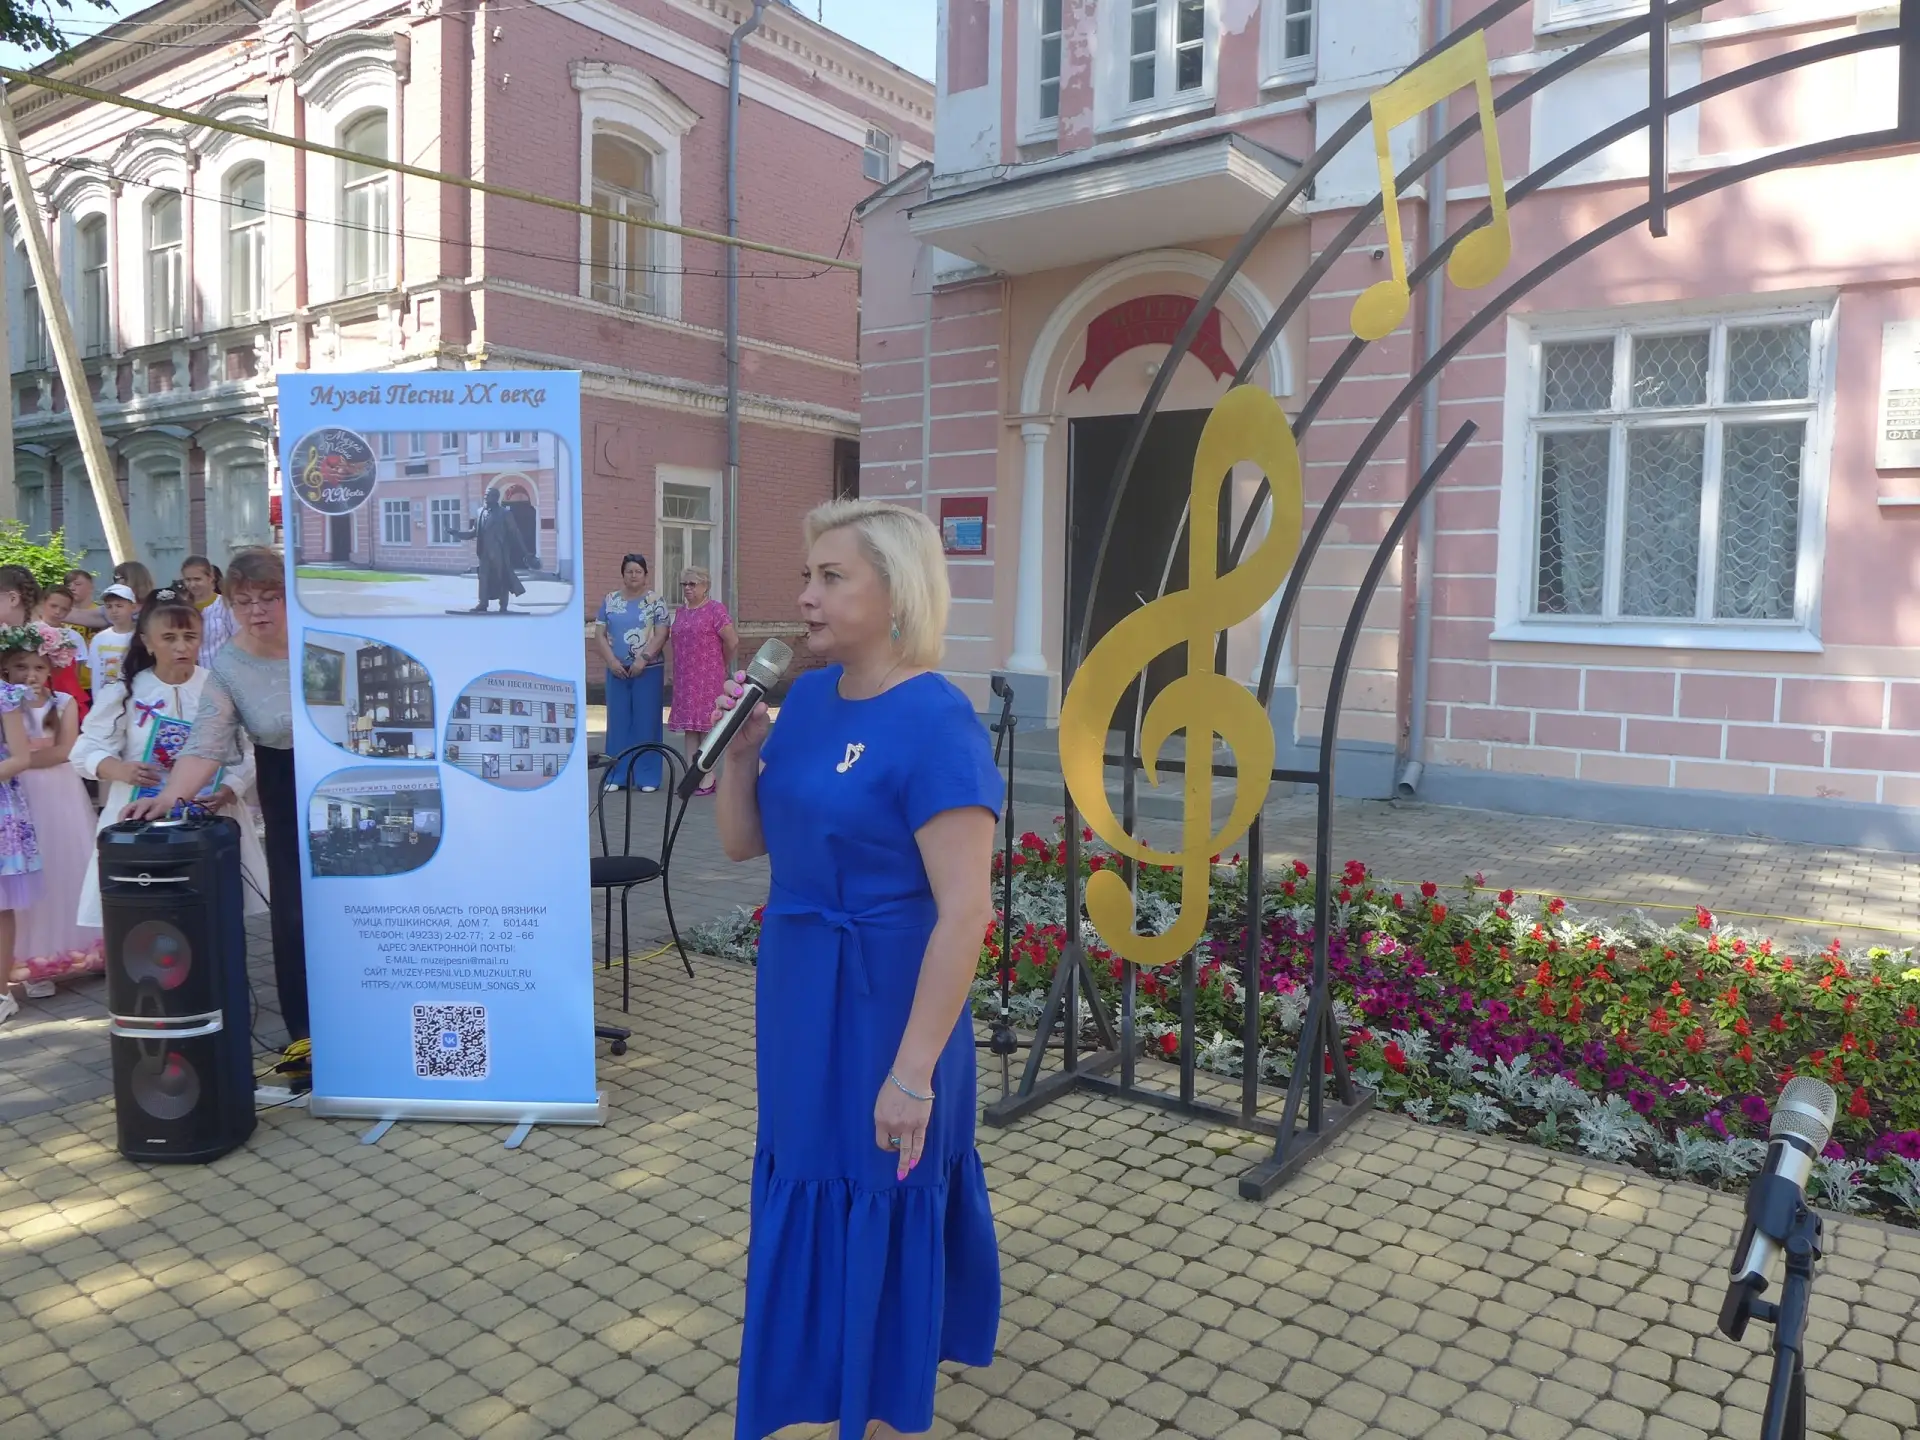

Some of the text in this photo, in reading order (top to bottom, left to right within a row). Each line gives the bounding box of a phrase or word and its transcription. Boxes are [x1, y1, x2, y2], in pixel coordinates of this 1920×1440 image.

[309, 382, 546, 411] Музей Песни XX века
[344, 906, 546, 915] ВЛАДИМИРСКАЯ ОБЛАСТЬ ГОРОД ВЯЗНИКИ
[353, 918, 382, 927] УЛИЦА
[458, 919, 481, 928] ДОМ
[504, 919, 539, 927] 601441
[360, 931, 403, 939] ТЕЛЕФОН:
[406, 931, 443, 940] (49233)
[445, 931, 483, 940] 2-02-77;
[378, 943, 516, 952] АДРЕС ЭЛЕКТРОННОЙ ПОЧТЫ:
[421, 957, 508, 966] muzejpesni@mail.ru
[391, 969, 531, 978] MUZEY-PESNI.VLD.MUZKULT.RU
[361, 981, 536, 991] HTTPS://VK.COM/MUSEUM_SONGS_XX
